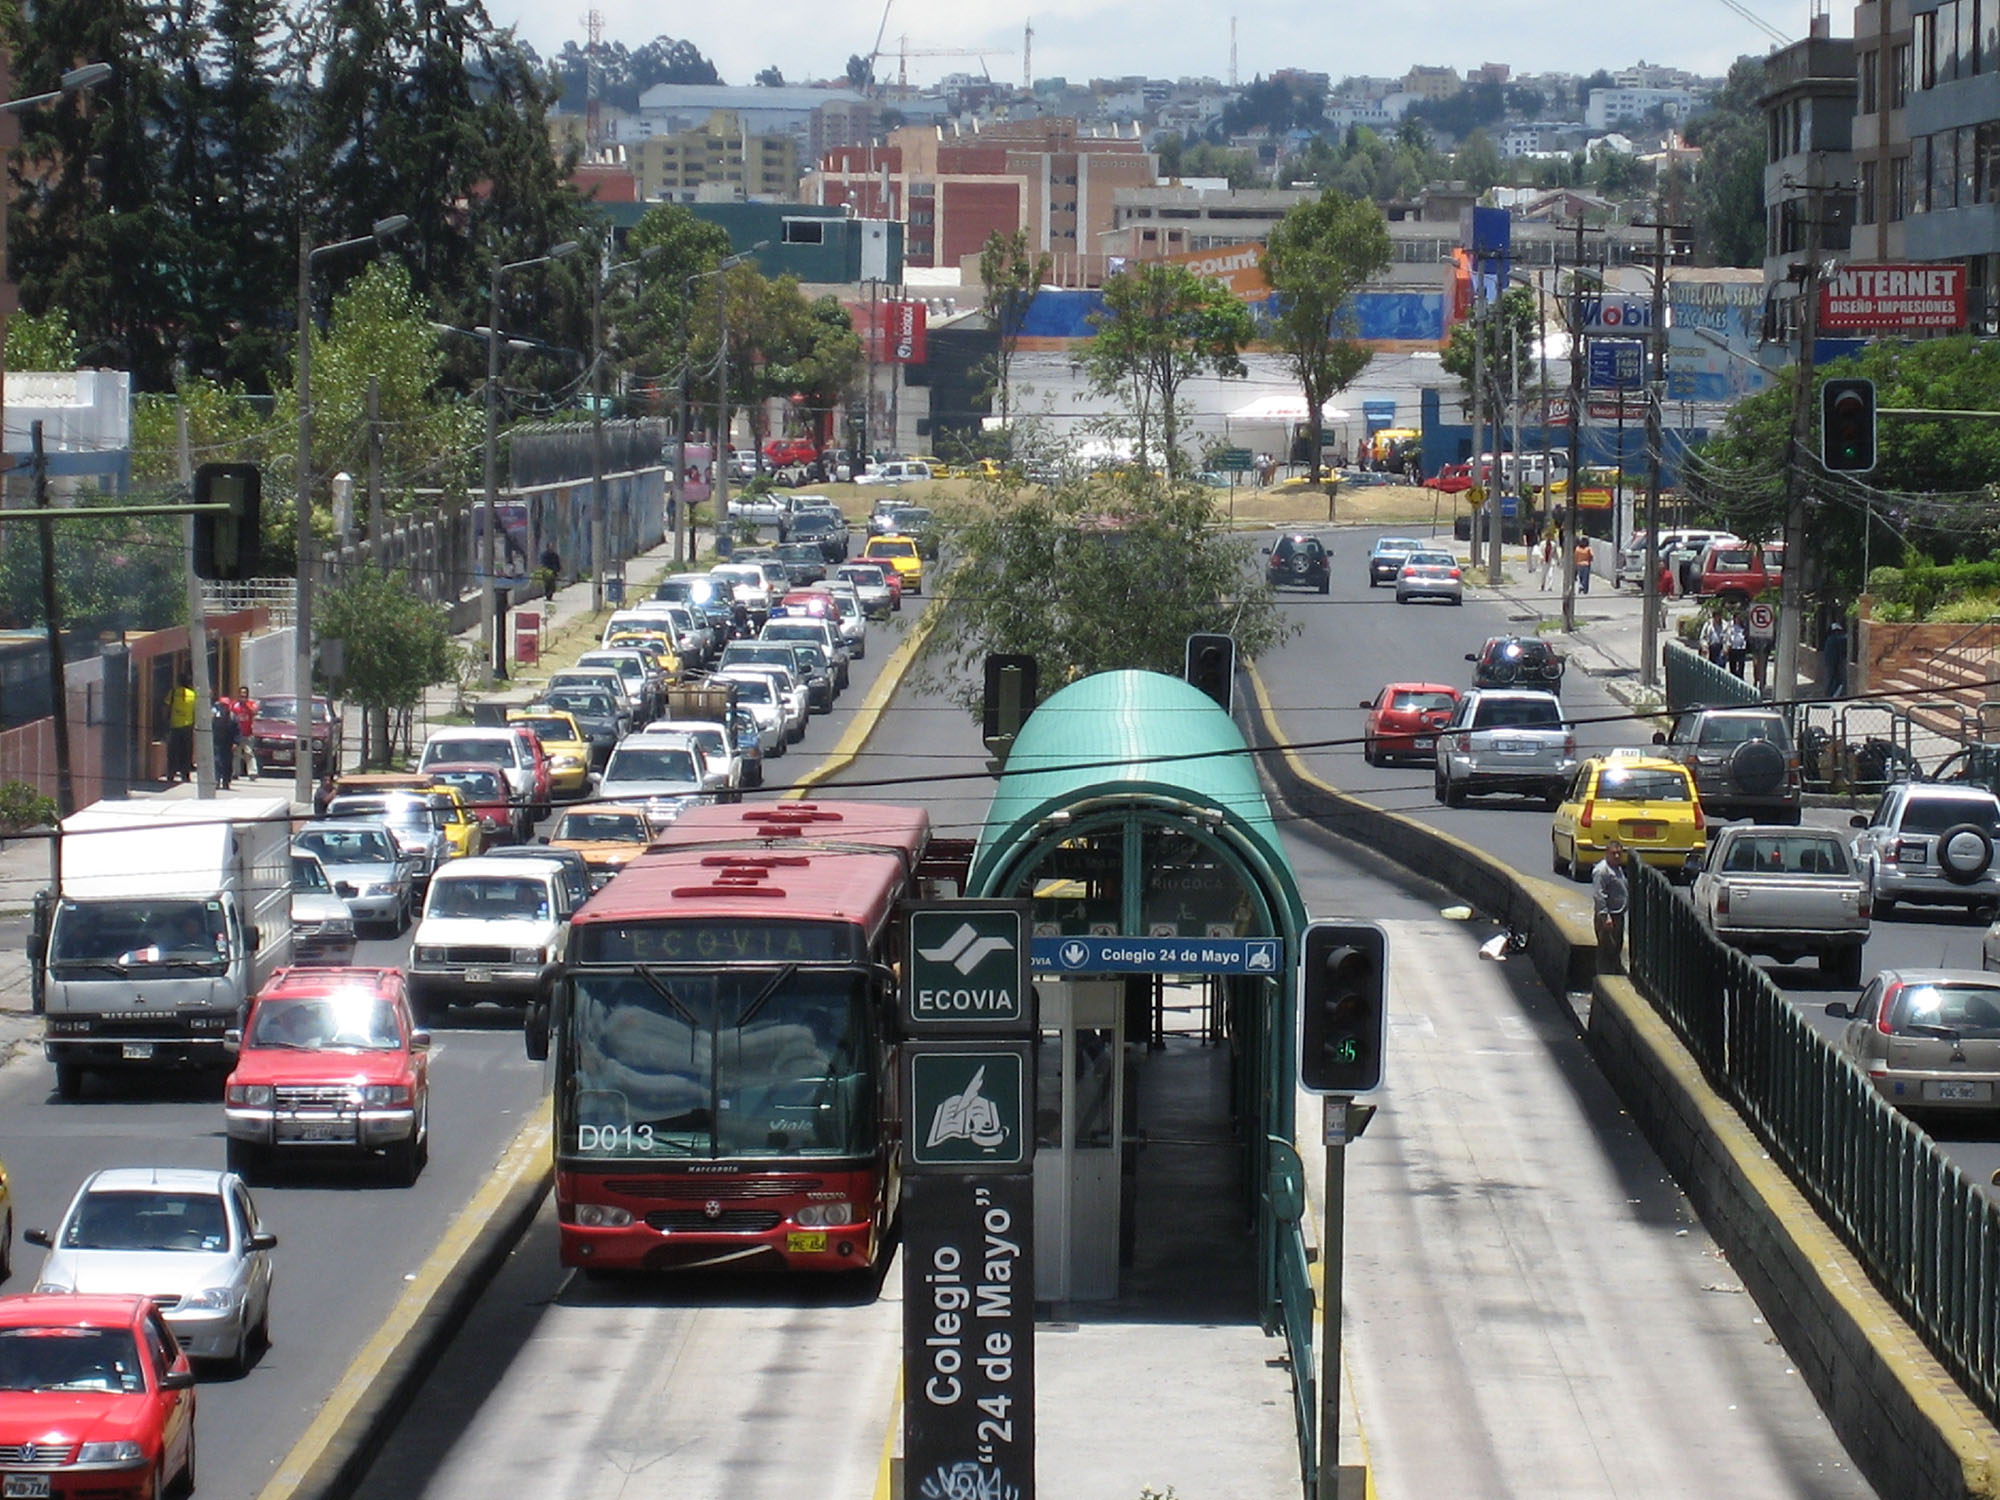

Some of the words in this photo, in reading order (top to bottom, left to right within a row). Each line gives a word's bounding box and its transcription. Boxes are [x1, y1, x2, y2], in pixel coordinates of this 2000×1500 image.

[1702, 286, 1727, 306] JUAN
[1829, 270, 1957, 297] INTERNET
[1574, 299, 1652, 327] Mobi
[1830, 298, 1873, 313] DISEÑO
[1877, 300, 1956, 313] IMPRESIONES
[1672, 310, 1728, 329] TACAMES
[633, 930, 802, 956] ECOVIA
[1101, 948, 1156, 963] Colegio
[1160, 949, 1177, 961] 24
[1180, 949, 1198, 962] de
[1202, 949, 1240, 965] Mayo
[919, 989, 1013, 1010] ECOVIA
[578, 1124, 655, 1151] D013
[925, 1246, 970, 1405] Colegio
[976, 1332, 1012, 1382] de
